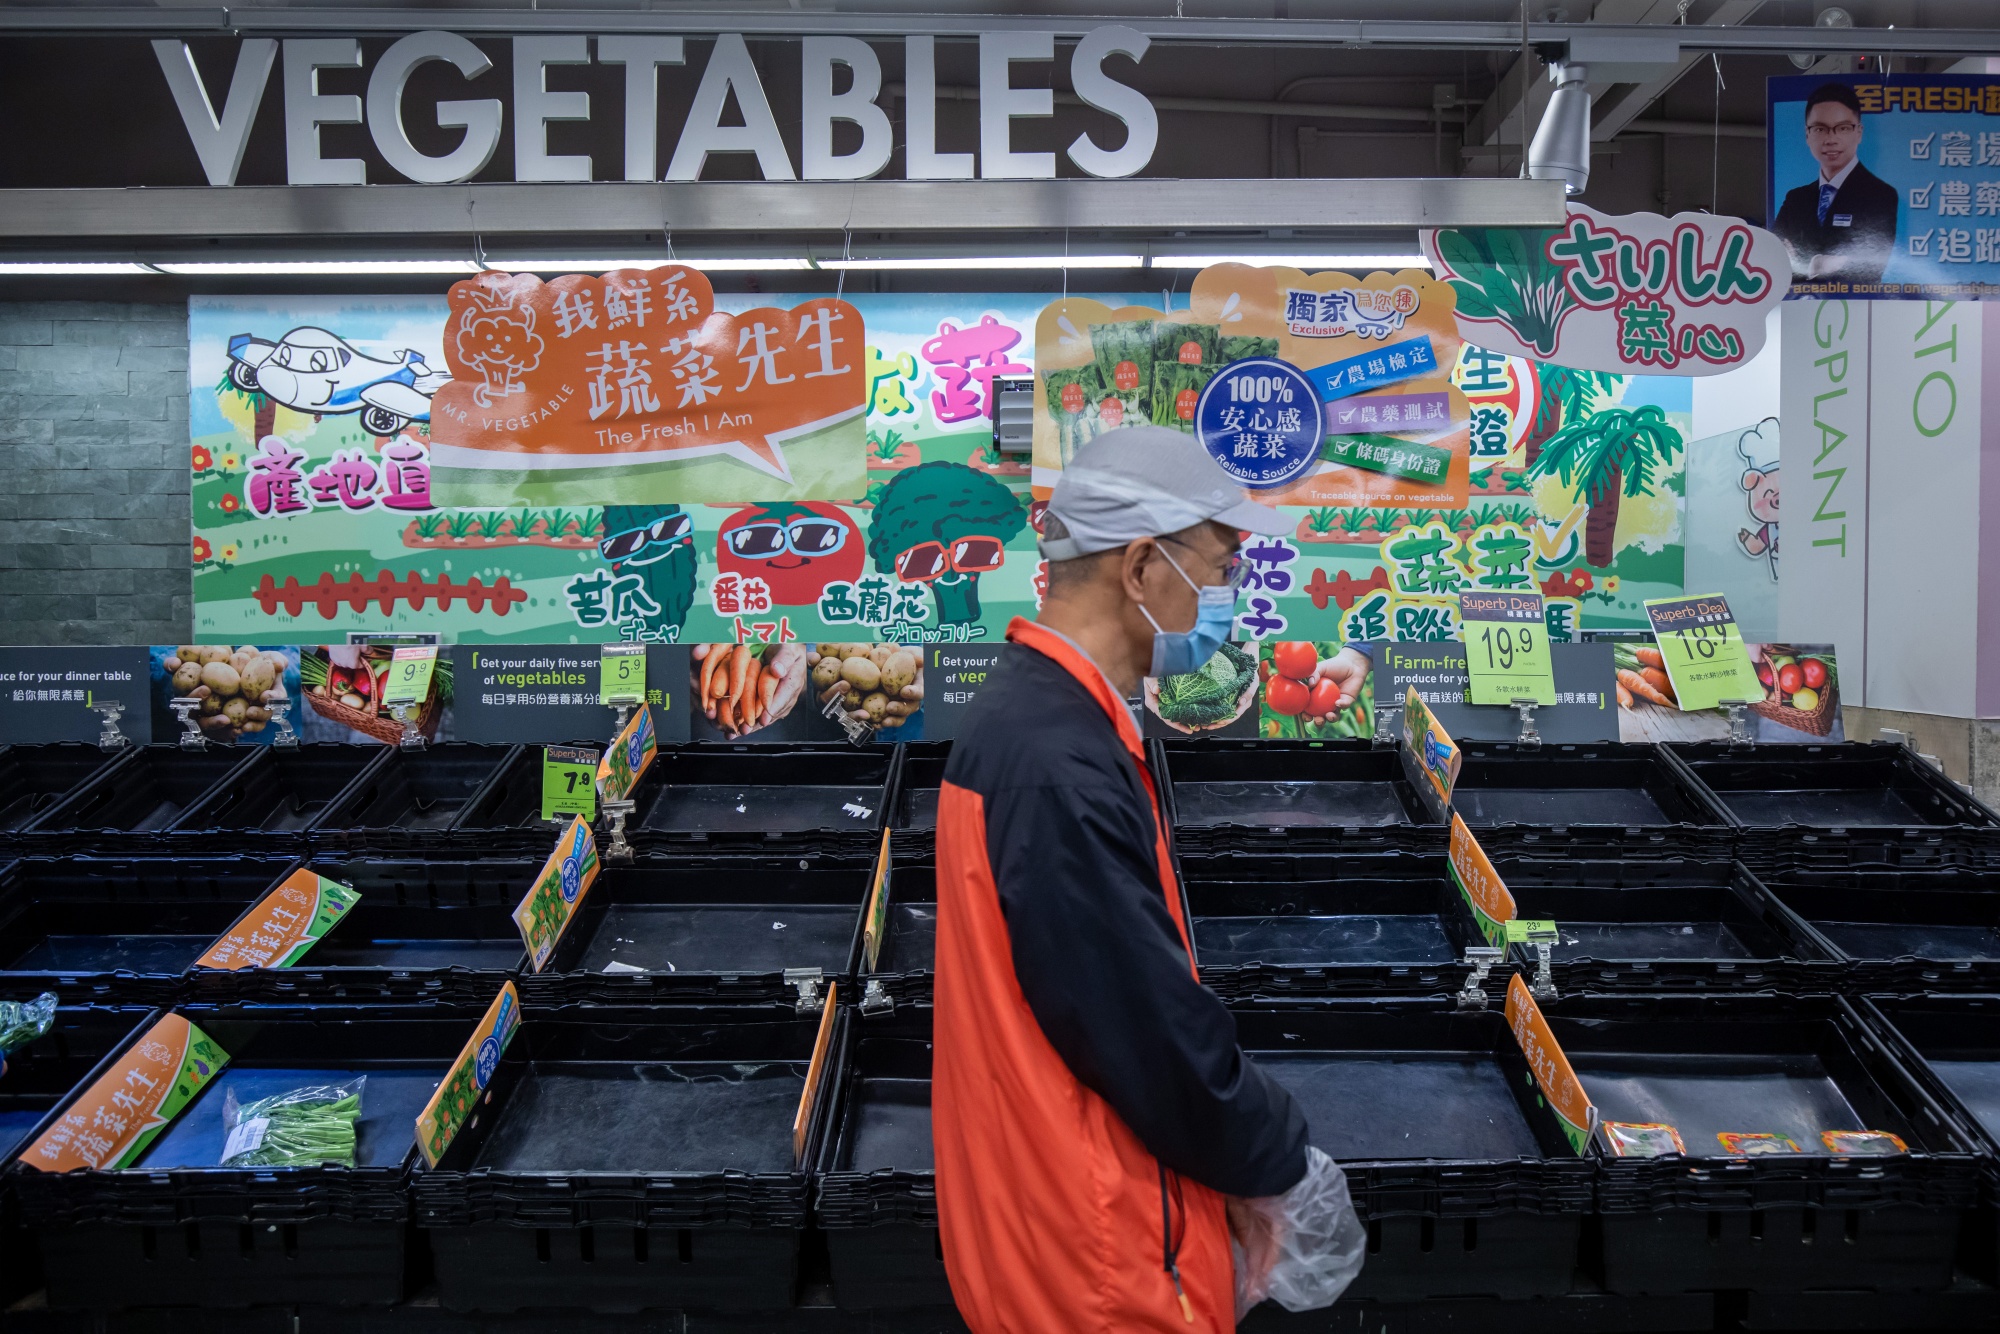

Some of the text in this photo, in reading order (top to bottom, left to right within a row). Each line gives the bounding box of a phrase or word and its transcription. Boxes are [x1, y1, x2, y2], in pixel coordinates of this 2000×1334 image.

[150, 25, 1158, 187] VEGETABLES
[1554, 222, 1763, 302] さいしん
[1786, 282, 1848, 294] raceable
[1853, 283, 1900, 294] source
[1904, 285, 1922, 294] on
[552, 270, 699, 339] 我鮮系
[1287, 291, 1348, 322] 獨家
[1292, 323, 1345, 335] Exclusive
[1620, 301, 1738, 363] 菜心
[586, 307, 851, 421] 蔬菜先生
[1347, 346, 1429, 385] 農場檢定
[1227, 376, 1293, 403] 100%
[442, 384, 574, 432] MR. VEGETABLE
[1220, 407, 1301, 432] 安心感
[1360, 401, 1445, 424] 農藥測試
[595, 429, 633, 447] The
[642, 416, 696, 441] Fresh
[717, 410, 753, 428] Am
[1233, 433, 1287, 459] 蔬菜
[1356, 441, 1441, 476] 條碼身份證
[1216, 453, 1300, 480] Reliable Source
[1311, 490, 1454, 503] Traceable source on vegetable
[567, 572, 657, 624] 苦瓜
[714, 576, 768, 613] 番茄
[821, 577, 926, 623] 西蘭花
[1241, 539, 1296, 636] 茄子
[1462, 596, 1540, 611] Superb Deal
[1652, 601, 1727, 623] Superb Deal
[735, 617, 796, 643] トマト
[1675, 623, 1727, 660] 18.9
[1482, 626, 1533, 669] 19.9
[403, 662, 427, 682] 9.9
[480, 658, 499, 668] Get
[502, 660, 527, 670] your
[529, 658, 556, 670] daily
[558, 658, 578, 668] five
[618, 659, 641, 679] 5.9
[942, 656, 961, 666] Get
[963, 658, 988, 668] your
[19, 670, 35, 681] for
[37, 672, 62, 683] your
[65, 670, 101, 681] dinner
[103, 670, 132, 681] table
[484, 671, 586, 688] of vegetables
[945, 673, 956, 683] of
[1394, 673, 1437, 685] produce
[1439, 673, 1455, 683] for
[549, 748, 596, 759] Superb Deal
[564, 771, 590, 794] 7.9
[71, 1067, 159, 1168] 蔬菜先生
[130, 1118, 142, 1131] The
[139, 1099, 155, 1117] Fresh
[156, 1082, 168, 1094] Am
